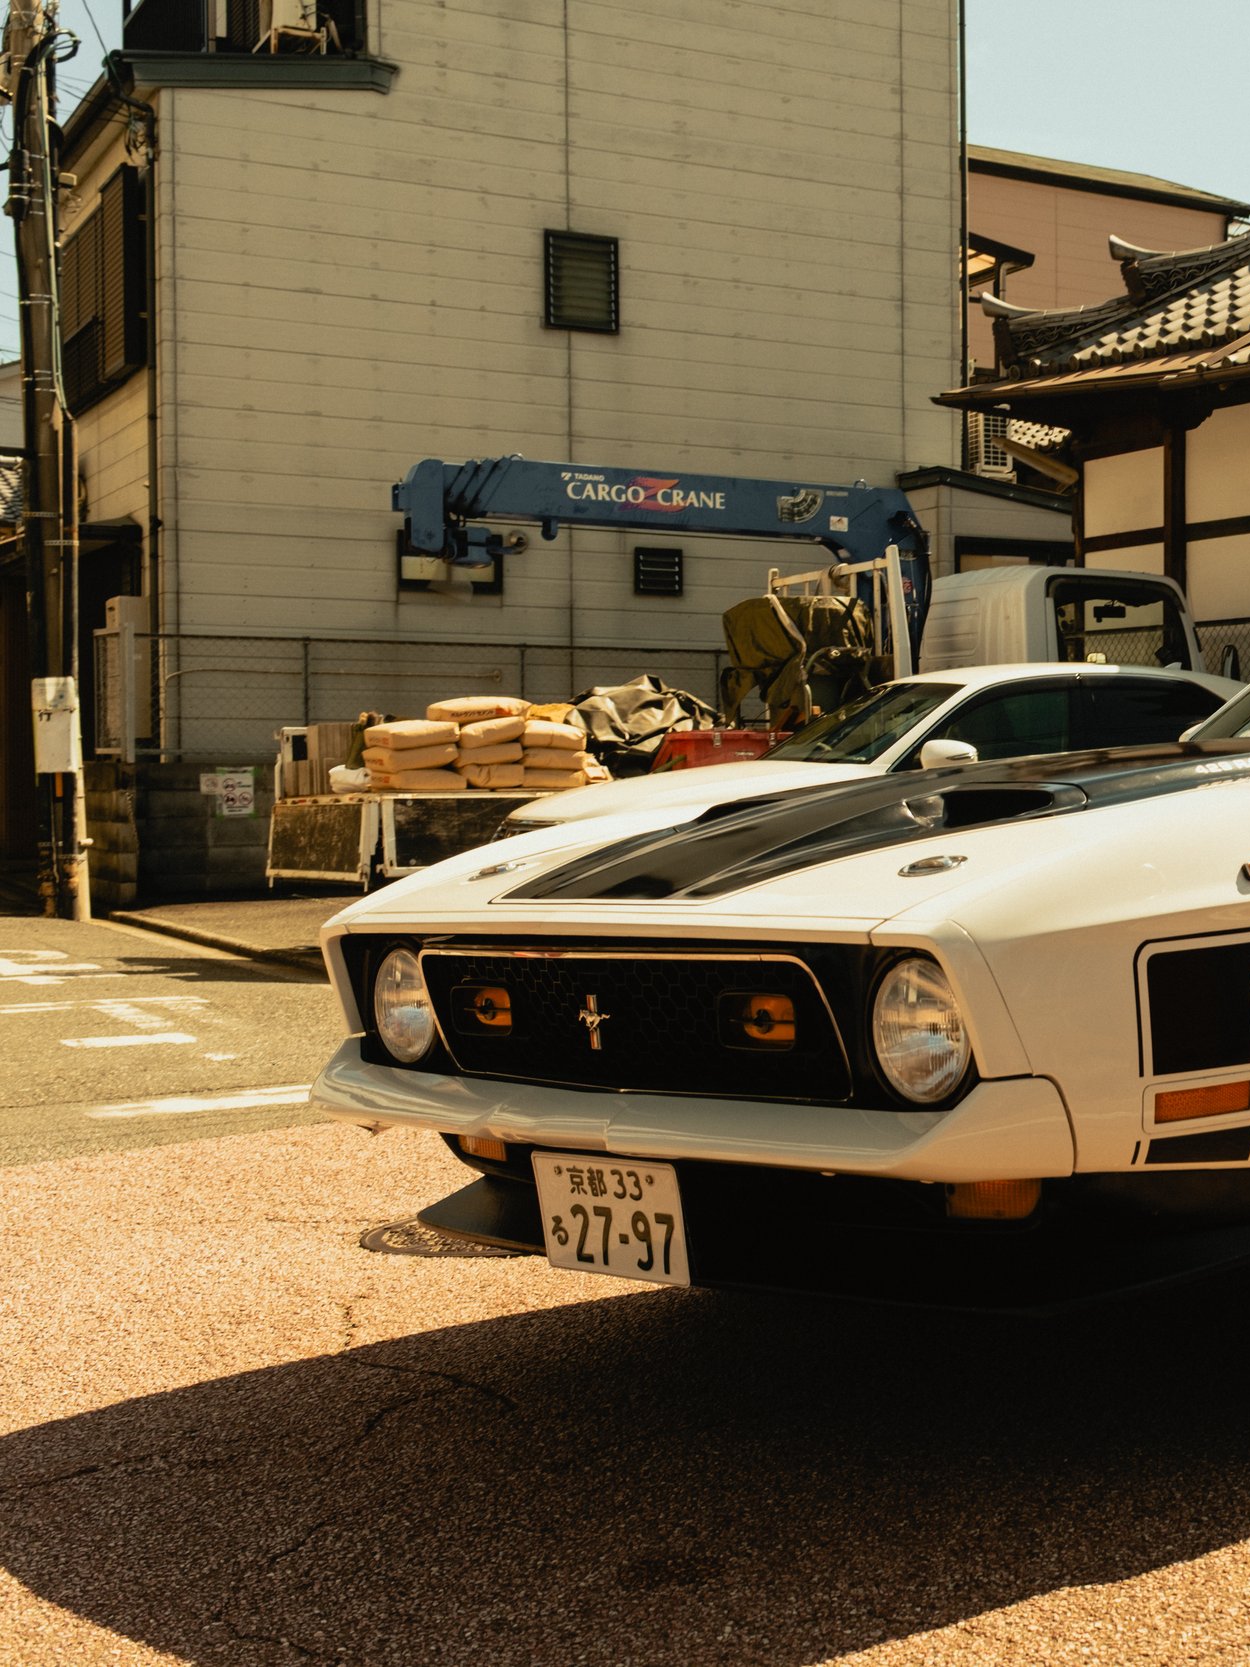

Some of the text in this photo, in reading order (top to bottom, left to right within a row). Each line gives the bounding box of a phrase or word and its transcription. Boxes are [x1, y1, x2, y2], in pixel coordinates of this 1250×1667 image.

[574, 472, 605, 482] TADANO
[566, 481, 645, 504] CARGO
[656, 488, 726, 510] CRANE
[566, 1165, 643, 1201] 京都 33
[552, 1203, 675, 1275] る 27-97
